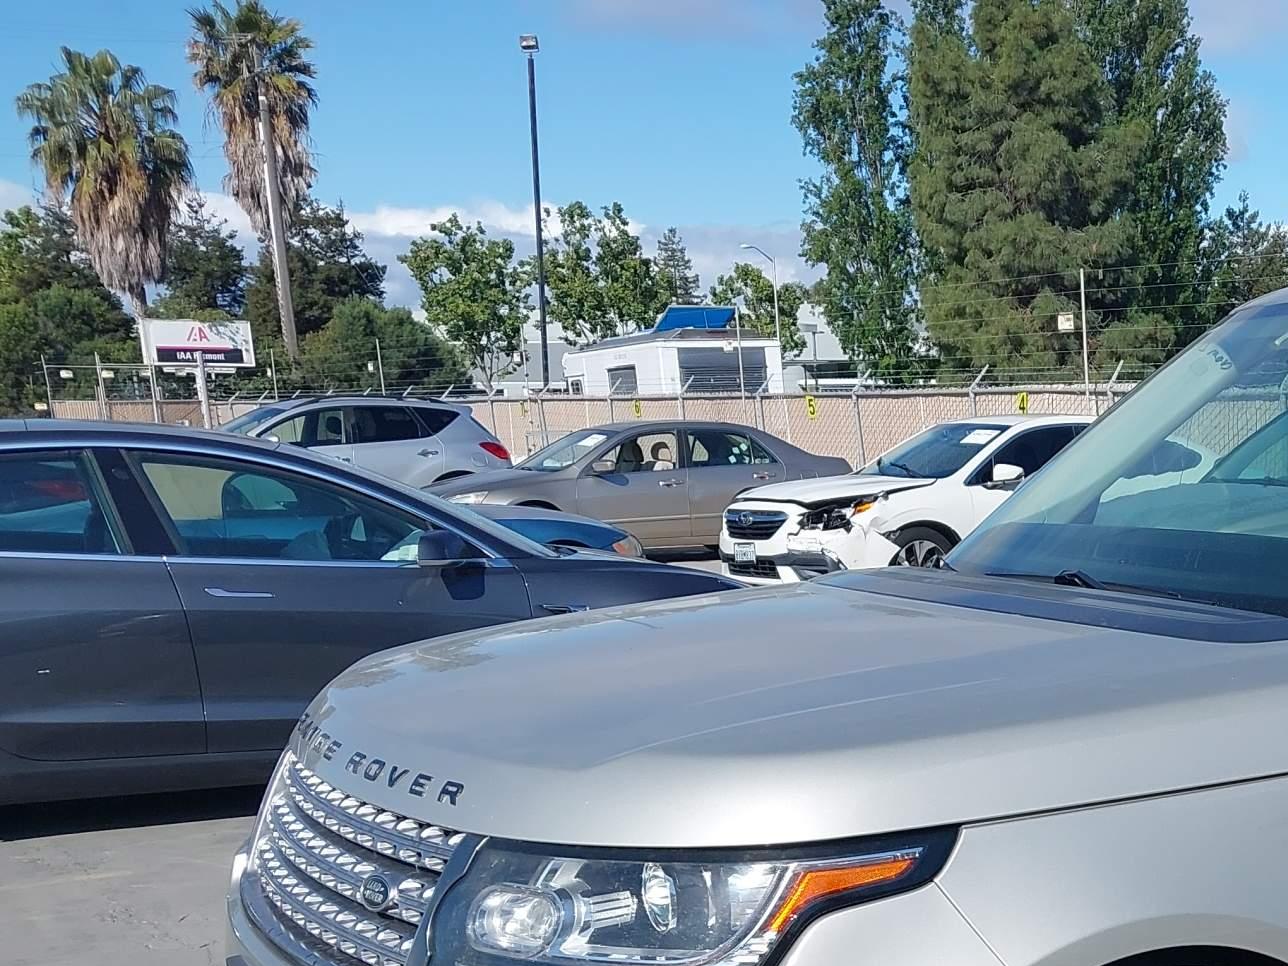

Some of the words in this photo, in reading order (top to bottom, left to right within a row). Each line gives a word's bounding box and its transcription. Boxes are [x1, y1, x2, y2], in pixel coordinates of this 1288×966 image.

[176, 352, 193, 360] IAA
[194, 351, 225, 361] Femont
[808, 398, 815, 415] 5
[1019, 394, 1026, 414] 4
[345, 751, 465, 806] ROVER
